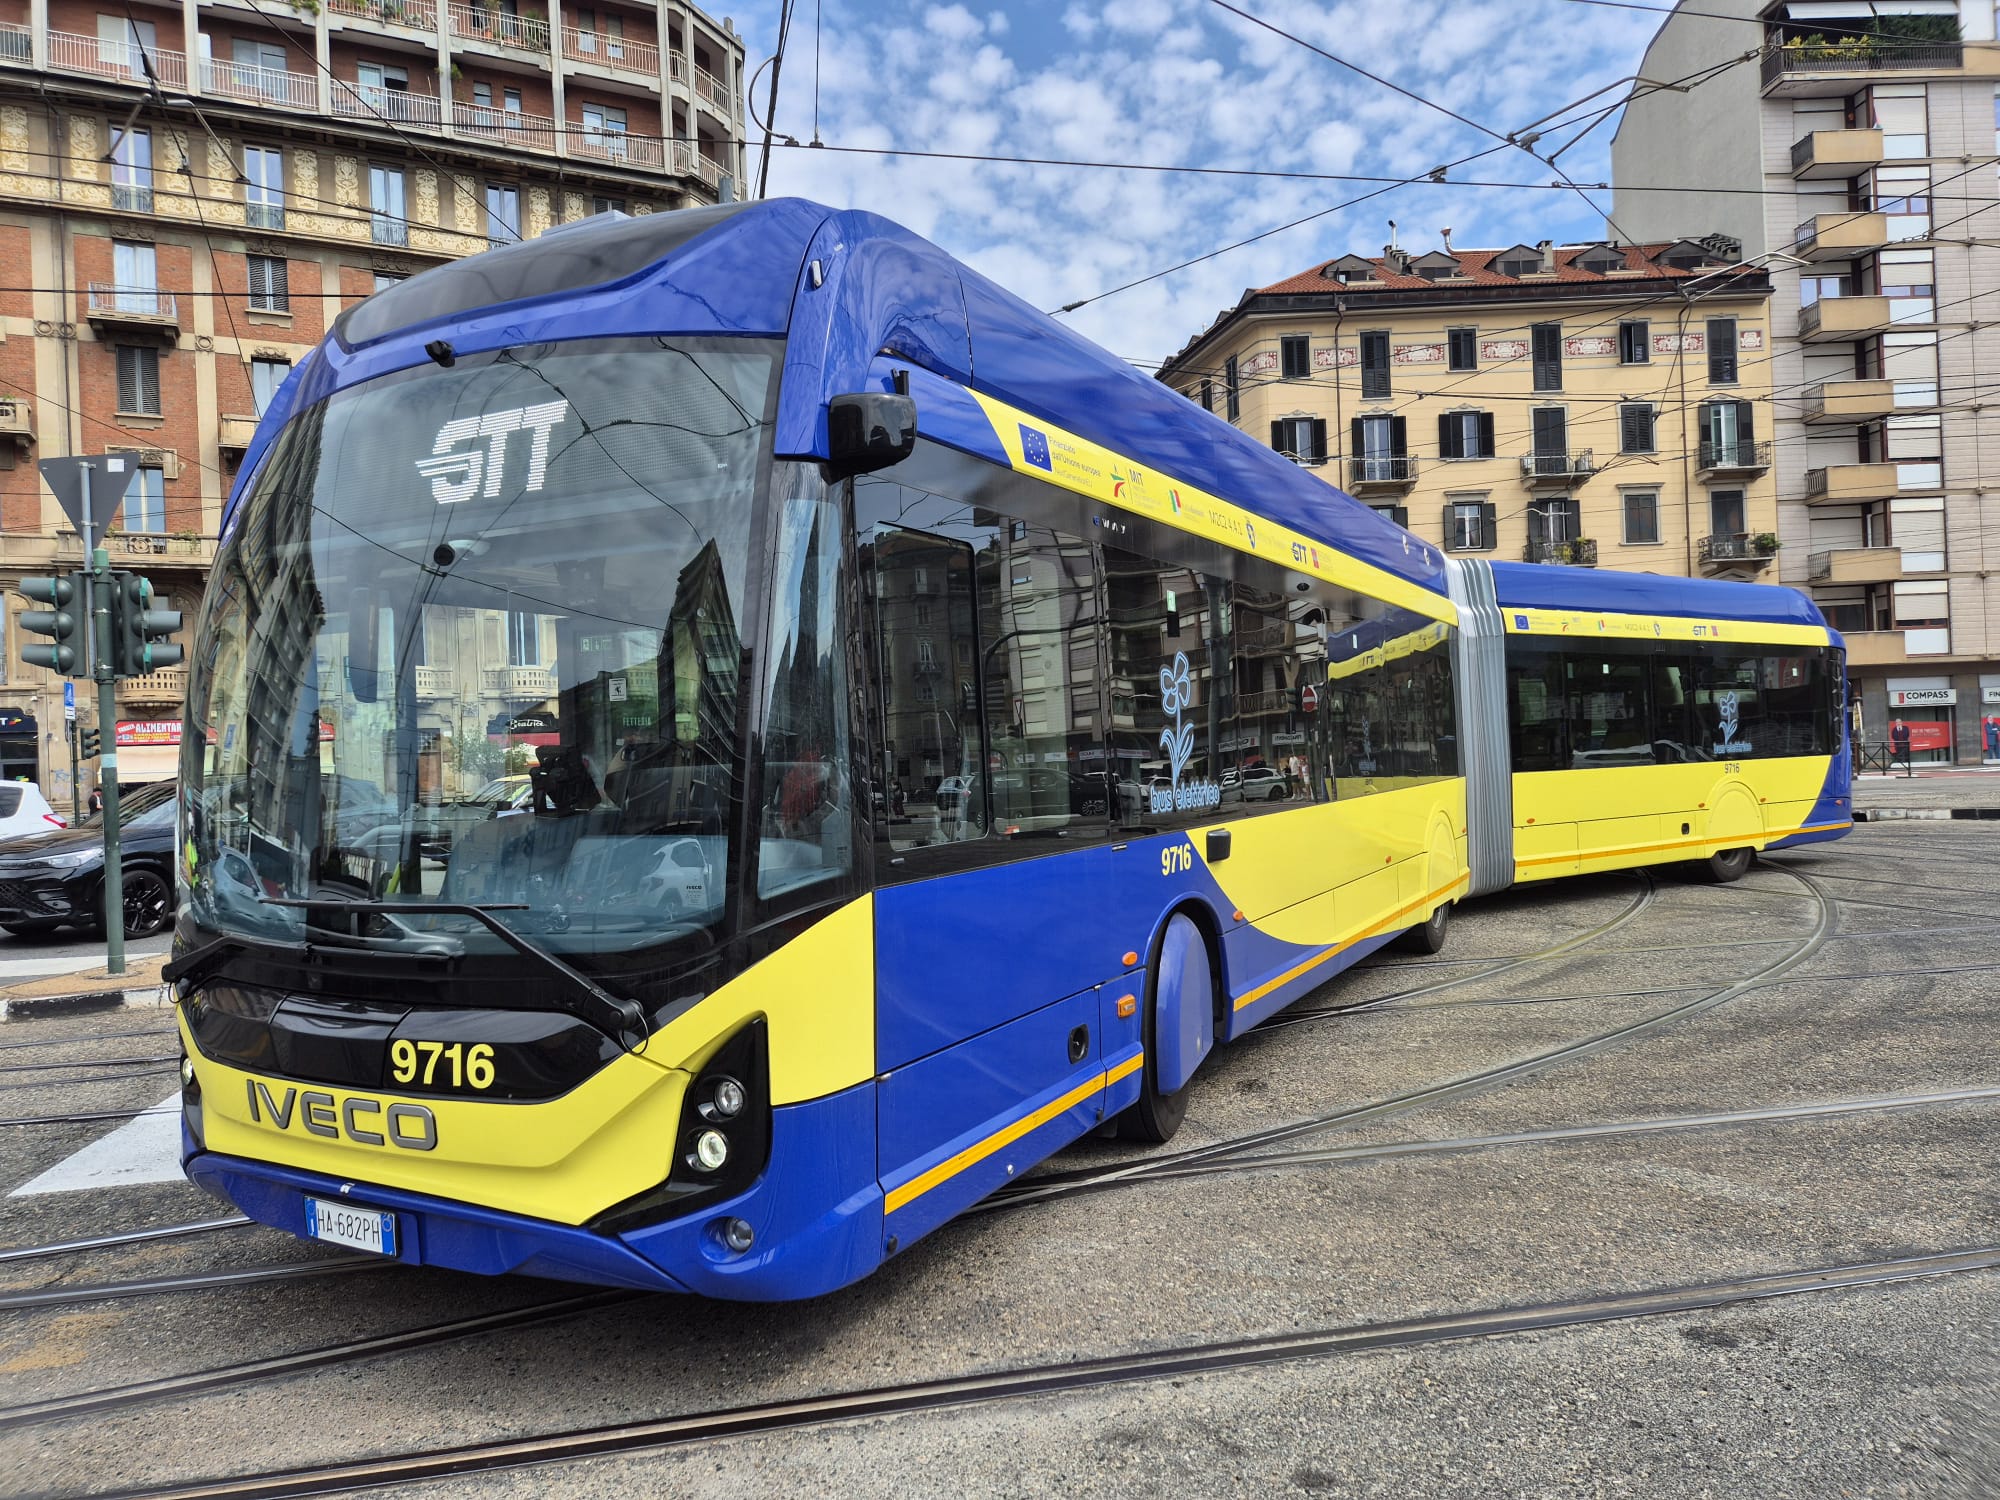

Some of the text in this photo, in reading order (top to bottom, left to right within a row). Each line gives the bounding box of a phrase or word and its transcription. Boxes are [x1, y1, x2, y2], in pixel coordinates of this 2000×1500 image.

[1906, 691, 1949, 700] COMPASS
[1724, 762, 1740, 774] 9716
[1150, 778, 1220, 814] bus elettrico
[1161, 842, 1192, 876] 9716
[391, 1039, 495, 1089] 9716
[246, 1079, 439, 1151] IVECO
